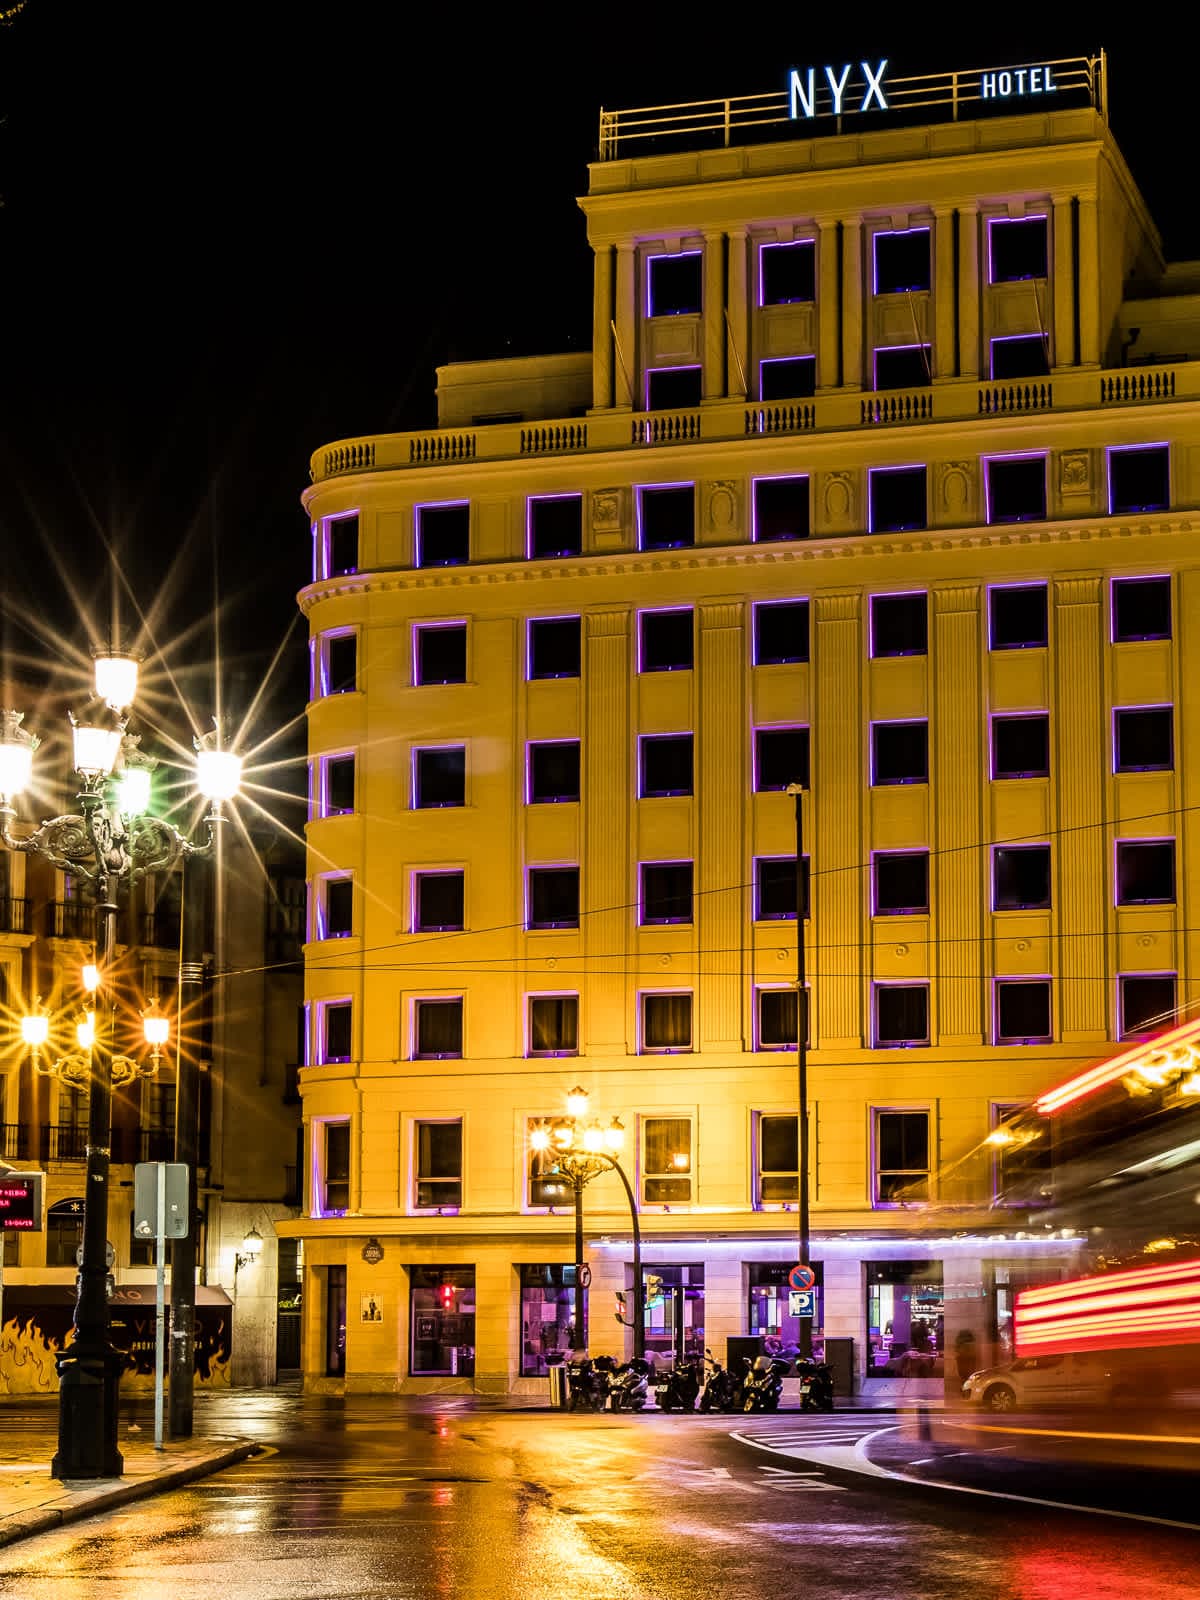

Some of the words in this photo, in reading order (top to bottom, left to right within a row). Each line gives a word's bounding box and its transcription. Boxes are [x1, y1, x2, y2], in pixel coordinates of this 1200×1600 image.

[790, 60, 888, 119] NYX
[981, 67, 1056, 98] HOTEL
[794, 1294, 810, 1314] P
